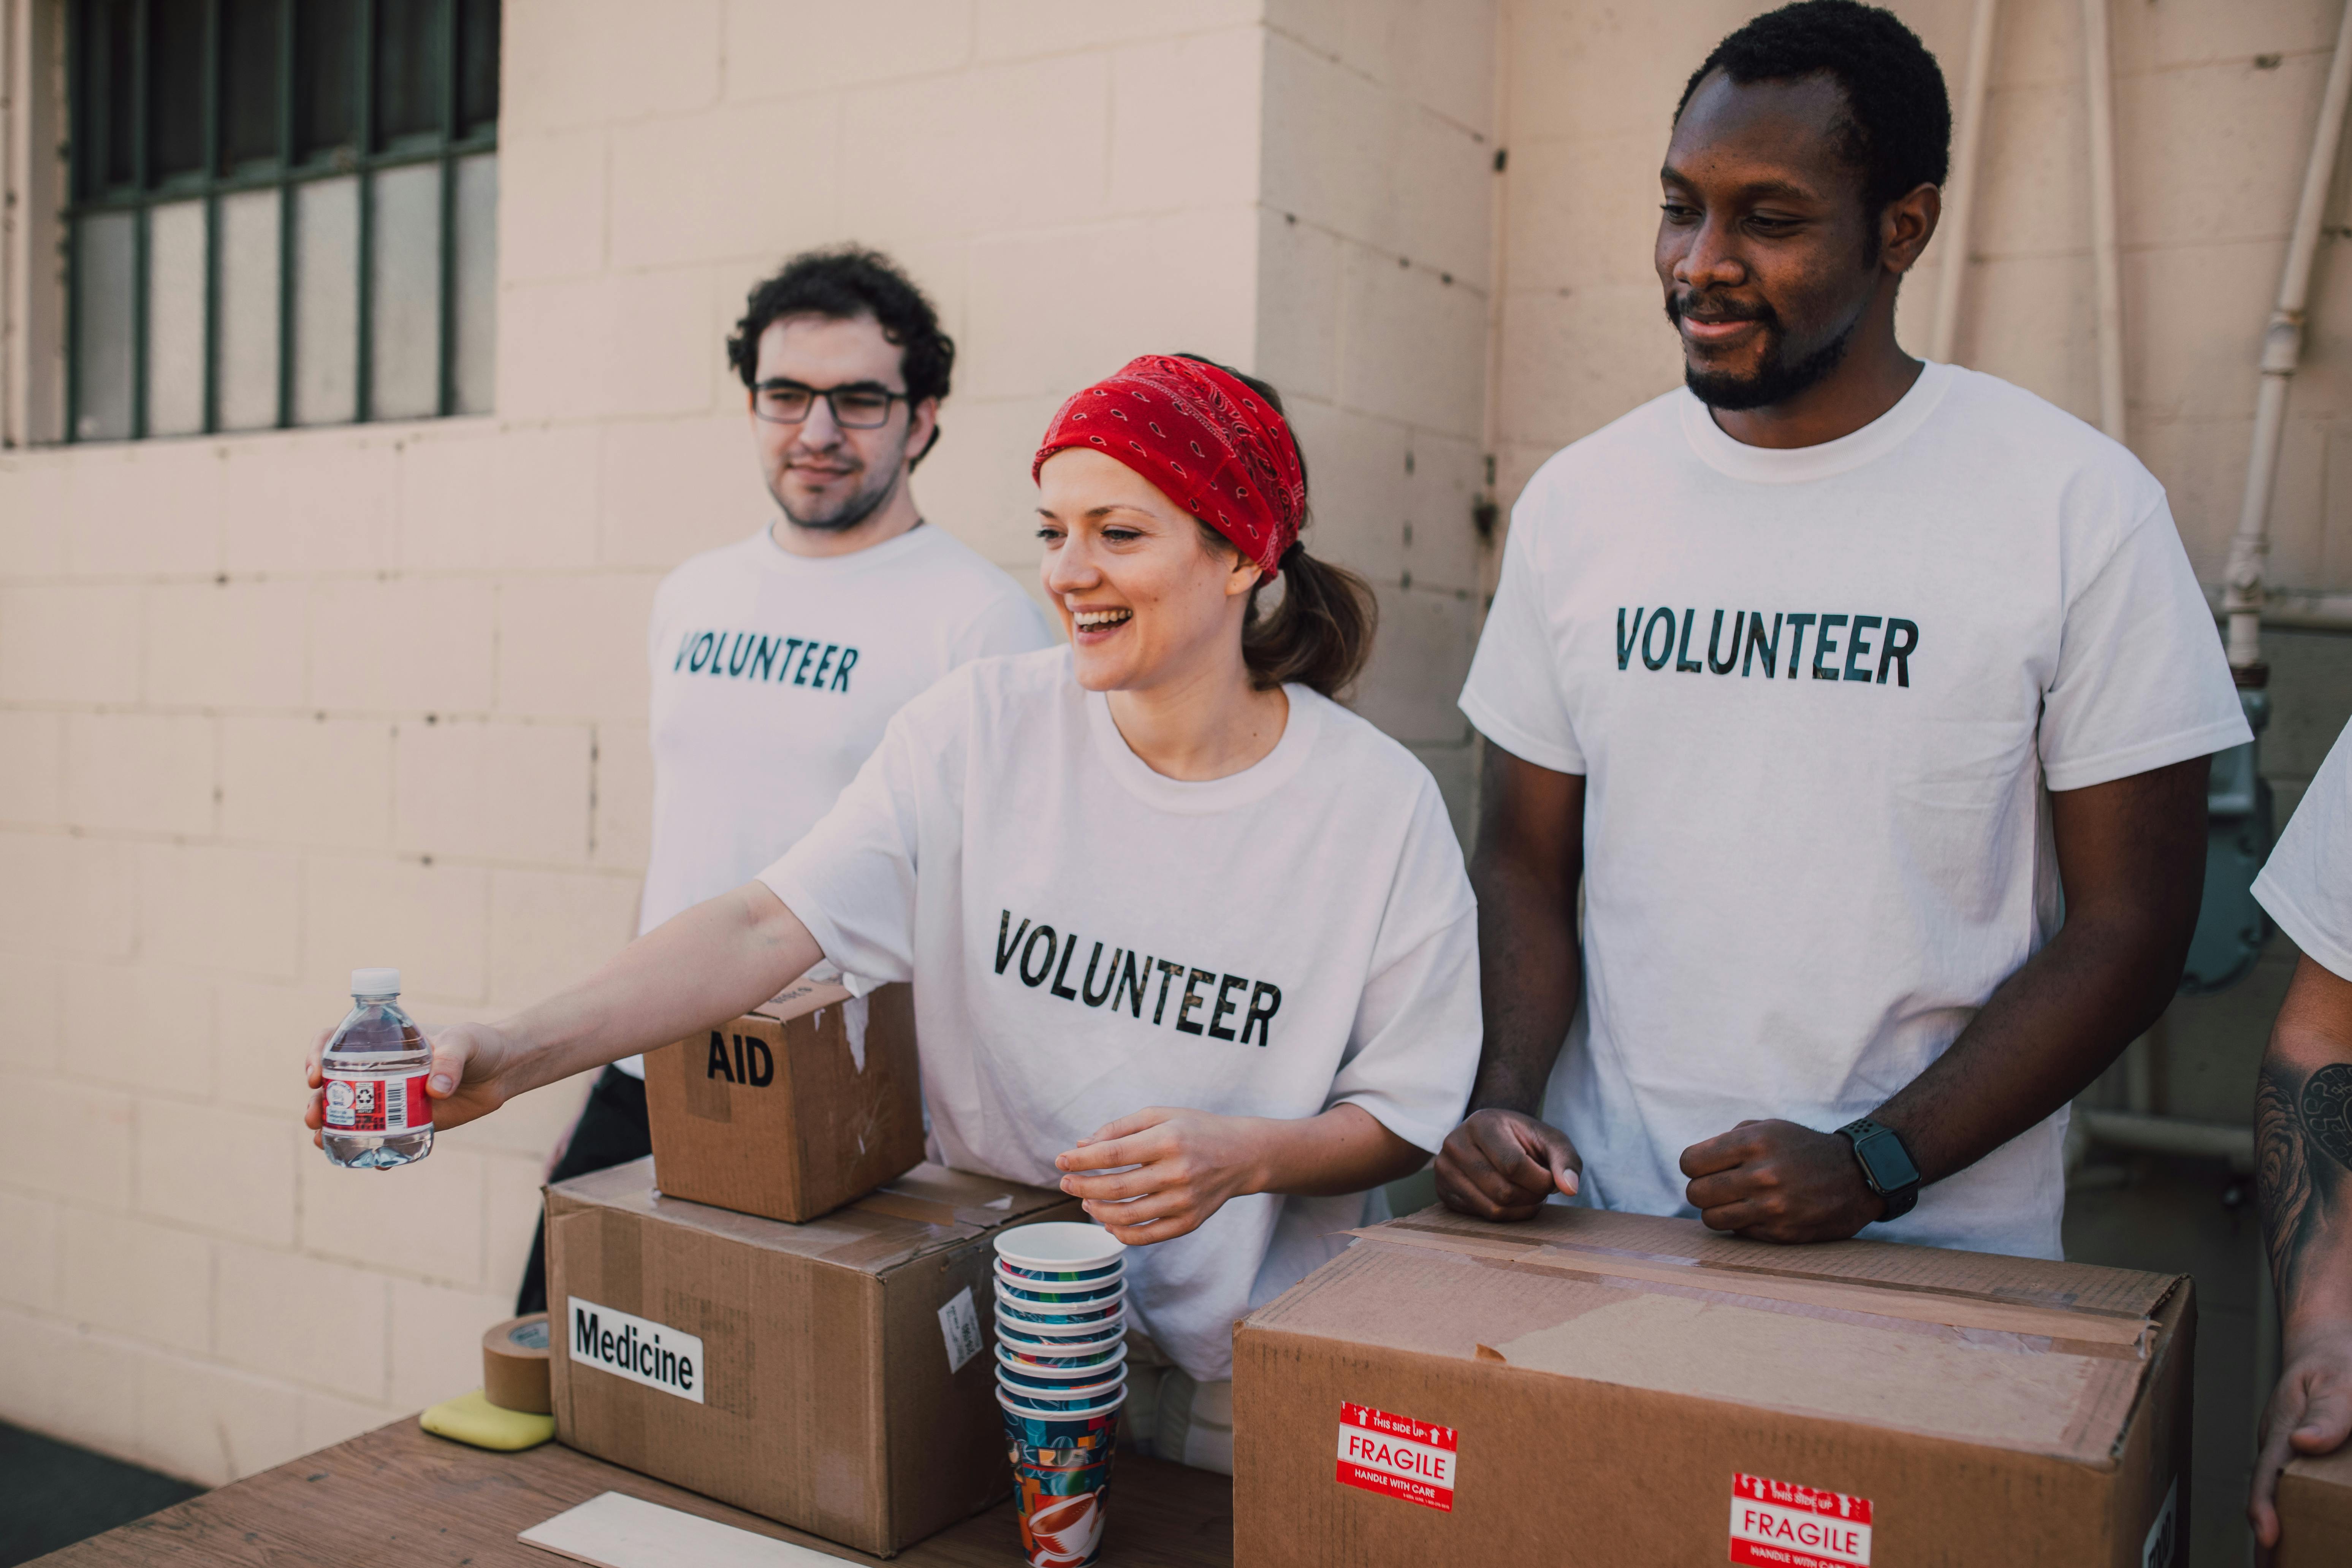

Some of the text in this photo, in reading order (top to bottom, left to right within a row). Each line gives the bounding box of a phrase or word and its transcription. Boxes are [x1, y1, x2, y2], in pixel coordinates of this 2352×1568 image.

[674, 631, 858, 692] VOLUNTEER
[1617, 607, 1919, 688] VOLUNTEER
[995, 909, 1282, 1047] VOLUNTEER
[707, 1030, 774, 1087] AID
[577, 1308, 693, 1390] Medicine
[1373, 1417, 1425, 1438] THIS SIDE UP
[1349, 1435, 1445, 1479] FRAGILE
[1355, 1468, 1388, 1486] HANDLE
[1390, 1477, 1410, 1491] WITH
[1412, 1484, 1435, 1498] CARE
[1772, 1490, 1833, 1510] THIS SIDE UP
[1744, 1510, 1858, 1555] FRAGILE
[1750, 1545, 1791, 1564] HANDLE
[1792, 1554, 1817, 1568] WITH
